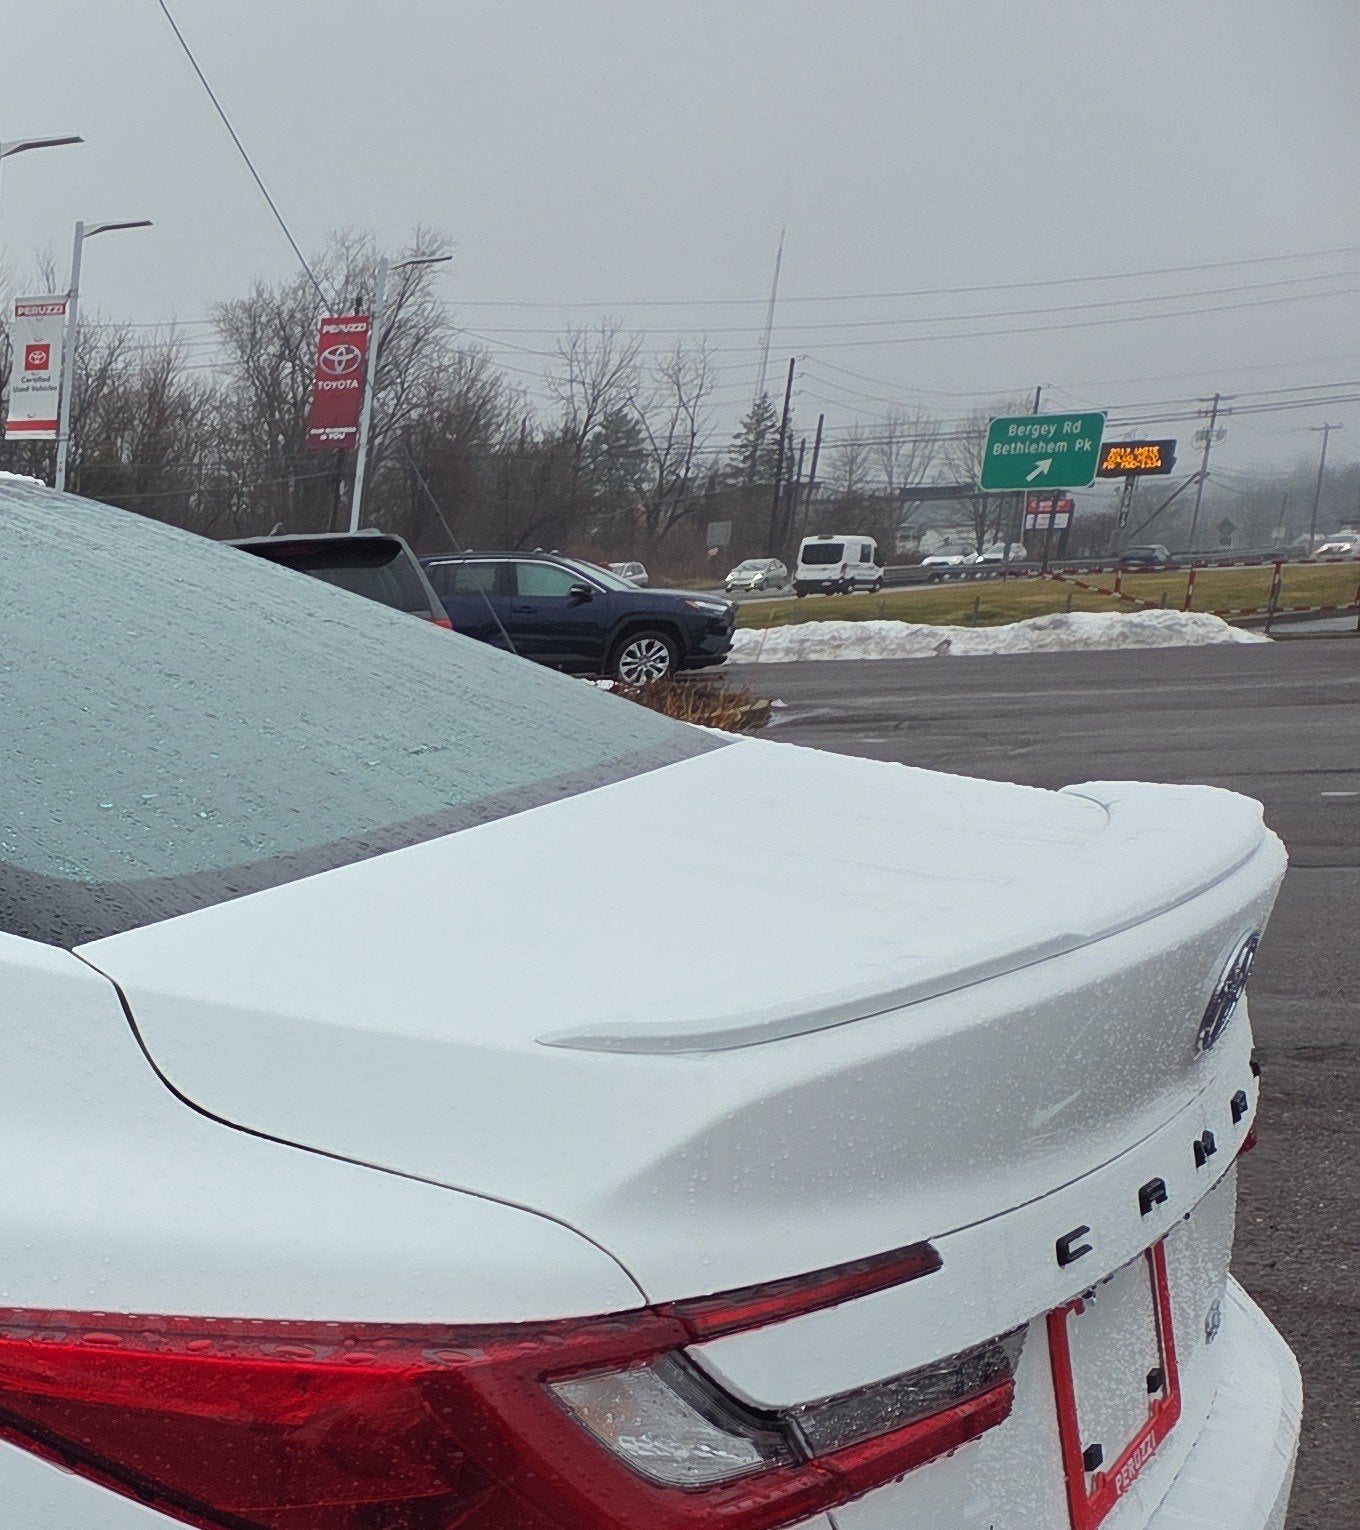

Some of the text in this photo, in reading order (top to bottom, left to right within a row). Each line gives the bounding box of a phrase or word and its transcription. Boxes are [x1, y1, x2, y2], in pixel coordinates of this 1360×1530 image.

[17, 305, 63, 315] PERUZZI
[318, 379, 359, 390] TOYOTA
[1008, 420, 1082, 438] Bergey Rd
[992, 438, 1092, 456] Bethlehem Pk
